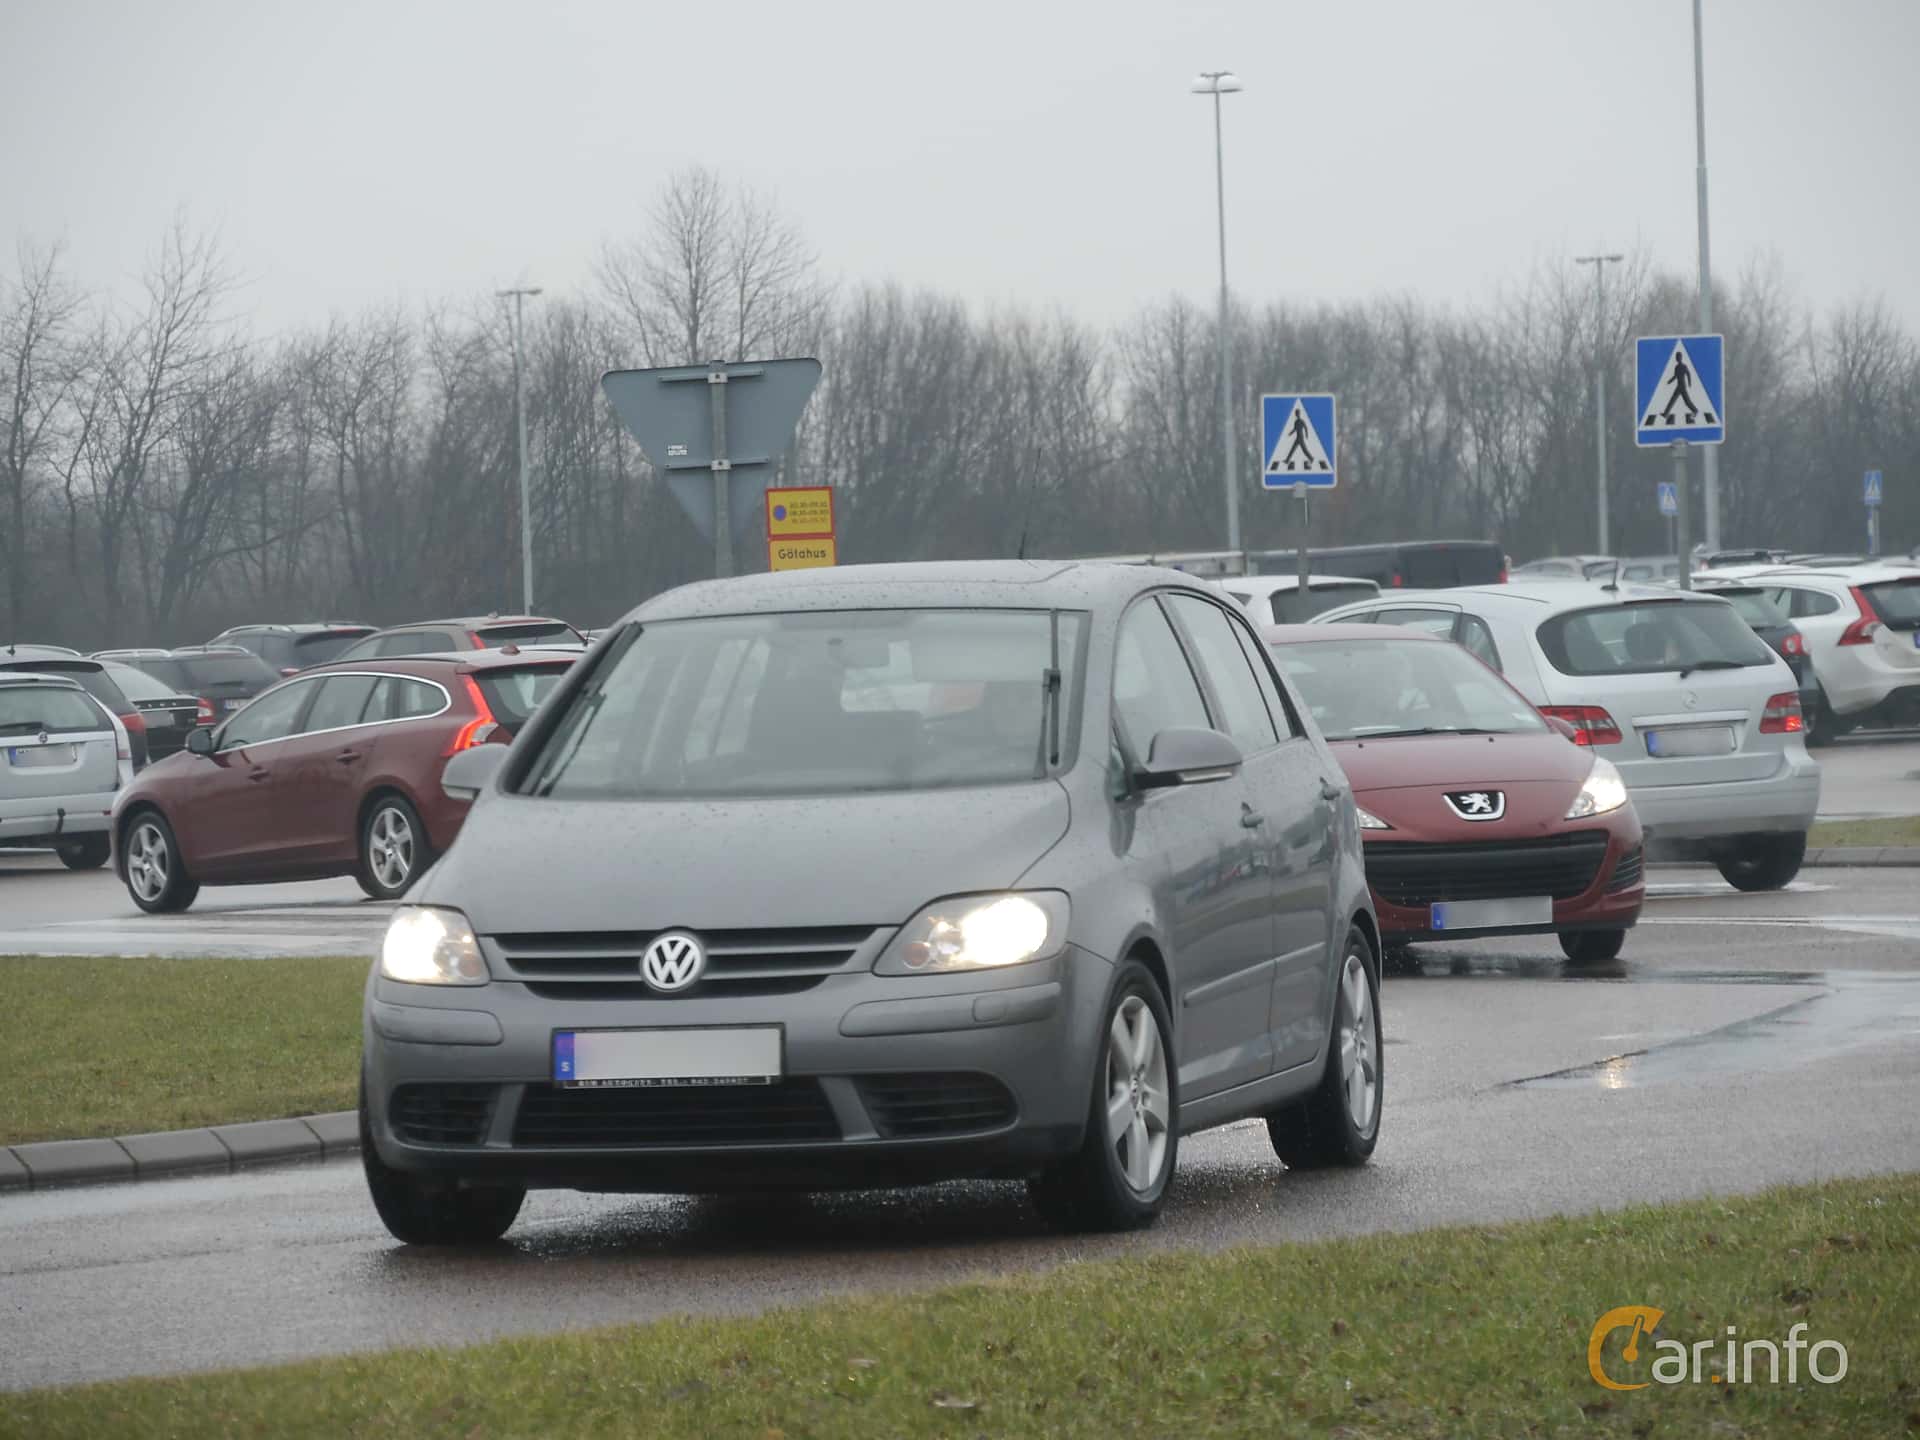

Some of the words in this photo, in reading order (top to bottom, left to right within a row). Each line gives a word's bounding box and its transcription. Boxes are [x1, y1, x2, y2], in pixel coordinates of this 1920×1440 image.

[778, 548, 826, 560] Götahus
[645, 937, 700, 987] VW
[561, 1061, 571, 1072] S
